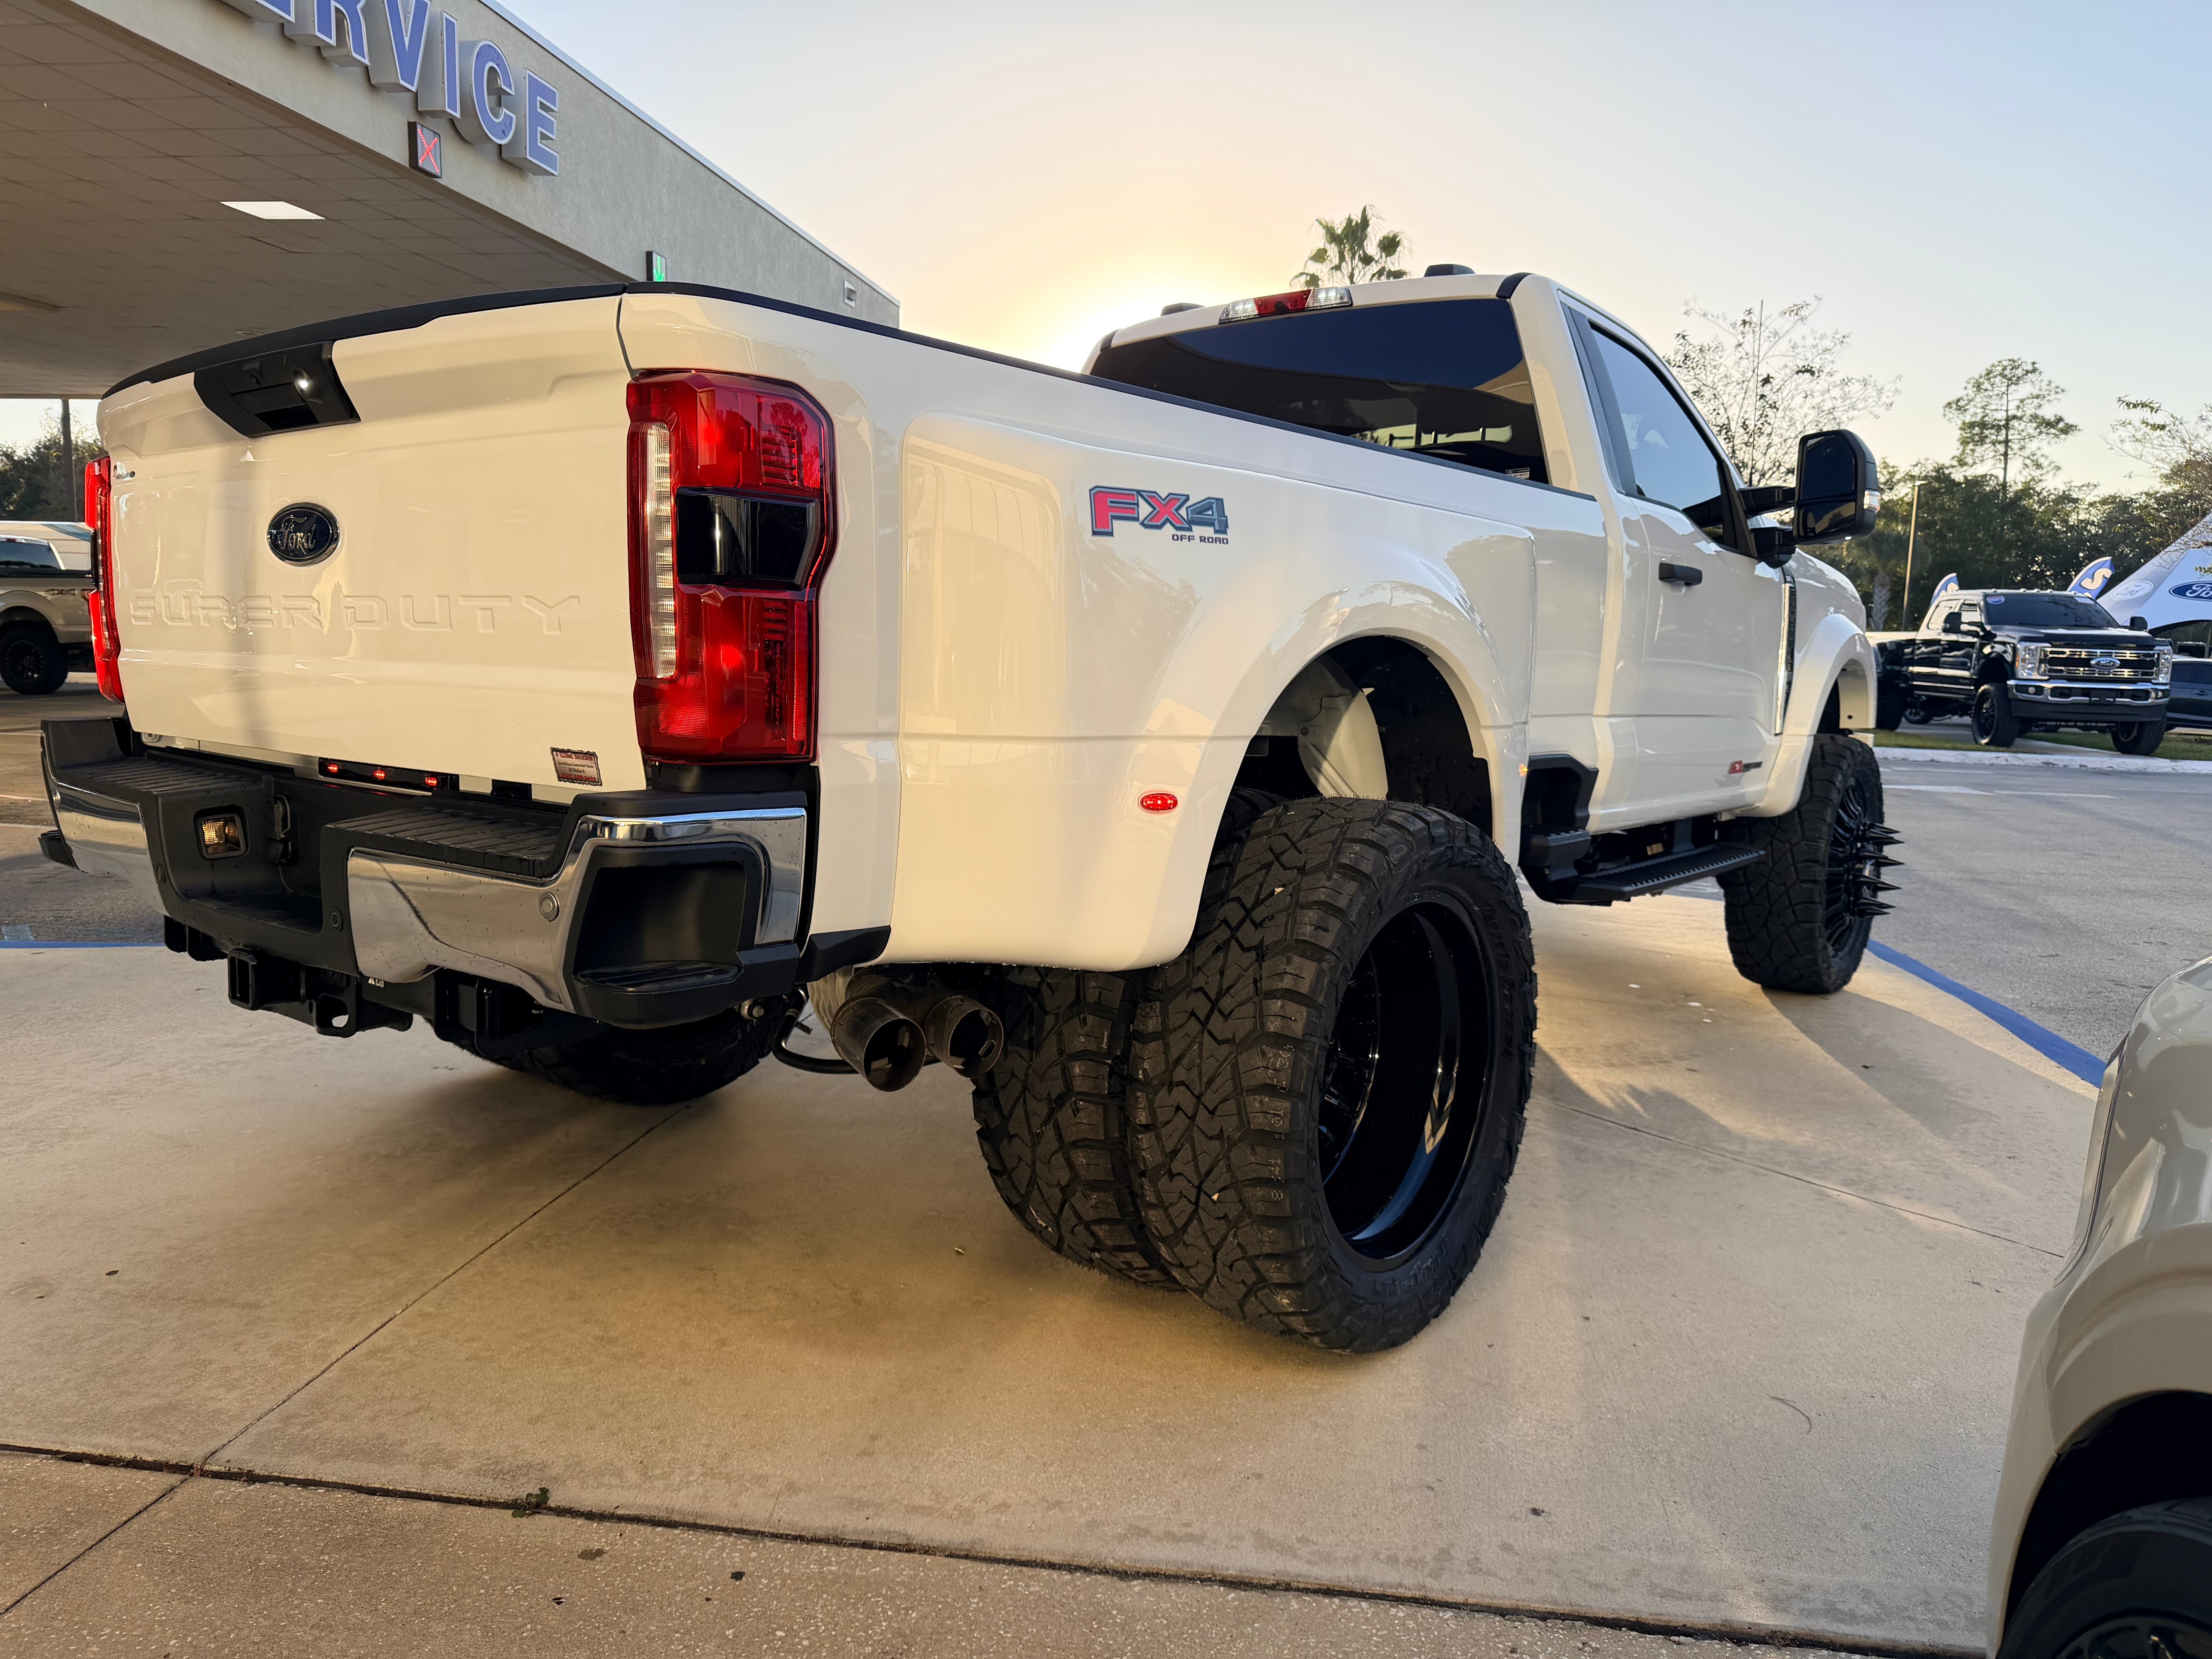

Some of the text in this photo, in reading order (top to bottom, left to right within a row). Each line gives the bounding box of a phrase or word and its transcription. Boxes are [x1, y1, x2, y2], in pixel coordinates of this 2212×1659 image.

[1089, 485, 1229, 538] FX4
[278, 515, 316, 555] Ford
[1172, 534, 1229, 545] OFF ROAD
[2186, 583, 2212, 598] Fo
[129, 594, 580, 635] SUPER DUTY
